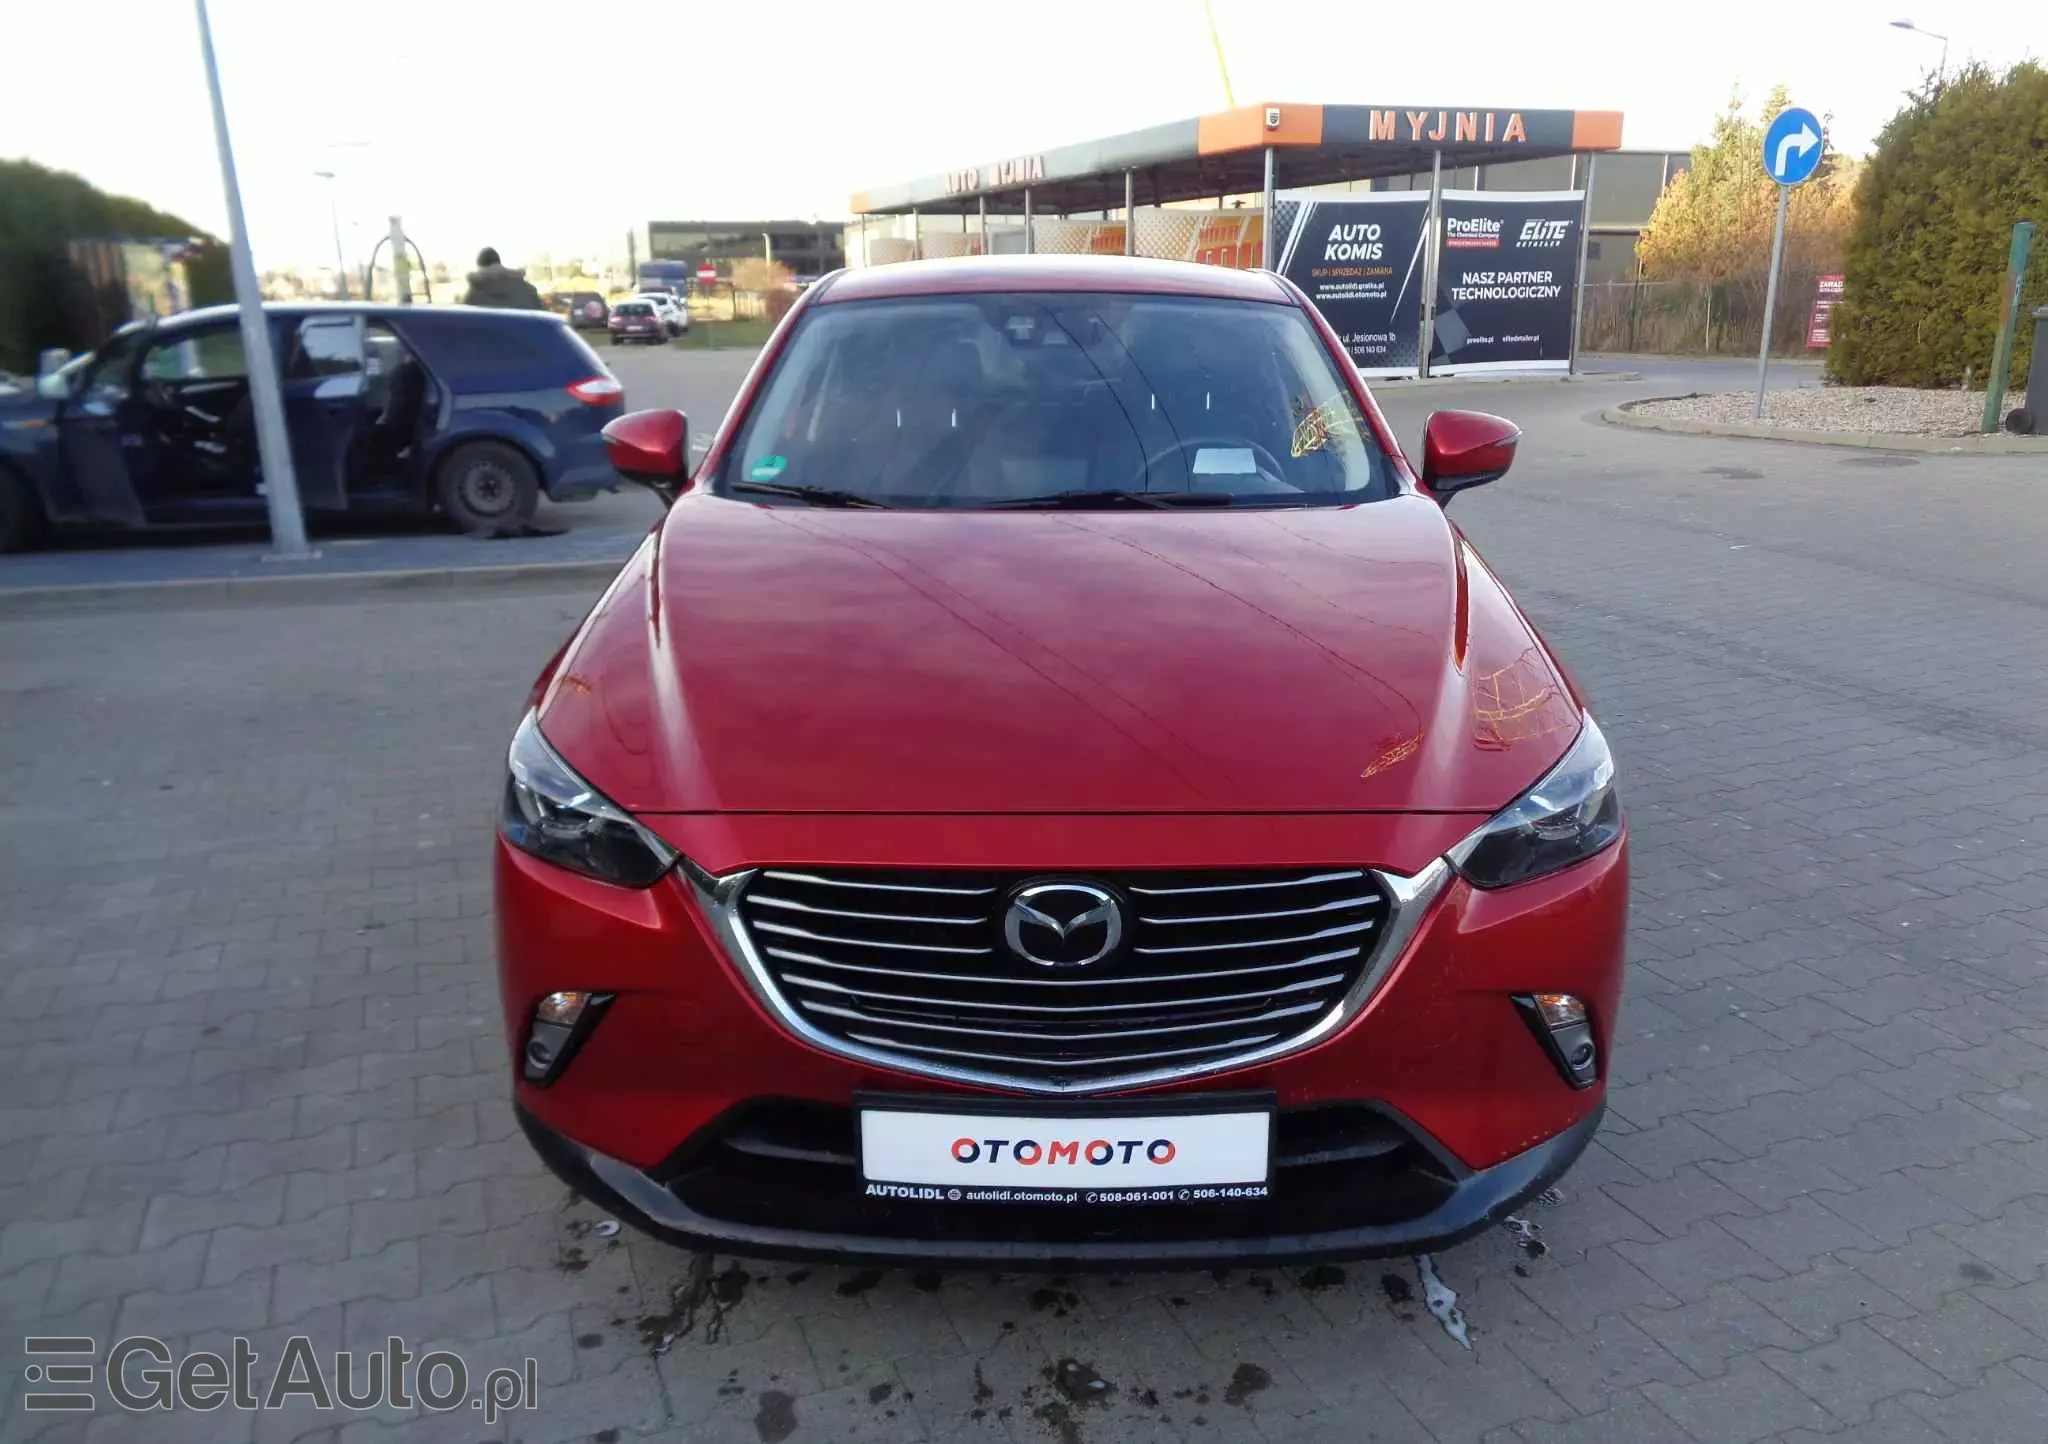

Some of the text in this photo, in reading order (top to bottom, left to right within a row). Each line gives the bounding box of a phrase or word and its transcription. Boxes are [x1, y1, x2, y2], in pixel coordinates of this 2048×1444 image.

[1368, 109, 1527, 142] MYJNIA
[1327, 223, 1382, 241] AUTO
[1447, 217, 1501, 233] ProElite
[1324, 242, 1384, 261] KOMIS
[1462, 270, 1553, 285] NASZ PARTNER
[1451, 285, 1561, 300] TECHNOLOGICZNY
[1351, 331, 1388, 343] Jesionowa
[950, 1137, 1177, 1166] OTOMOTO
[866, 1184, 1268, 1203] AUTOLIDL autolidl.otomoto.pl 508-061-001 506-140-634
